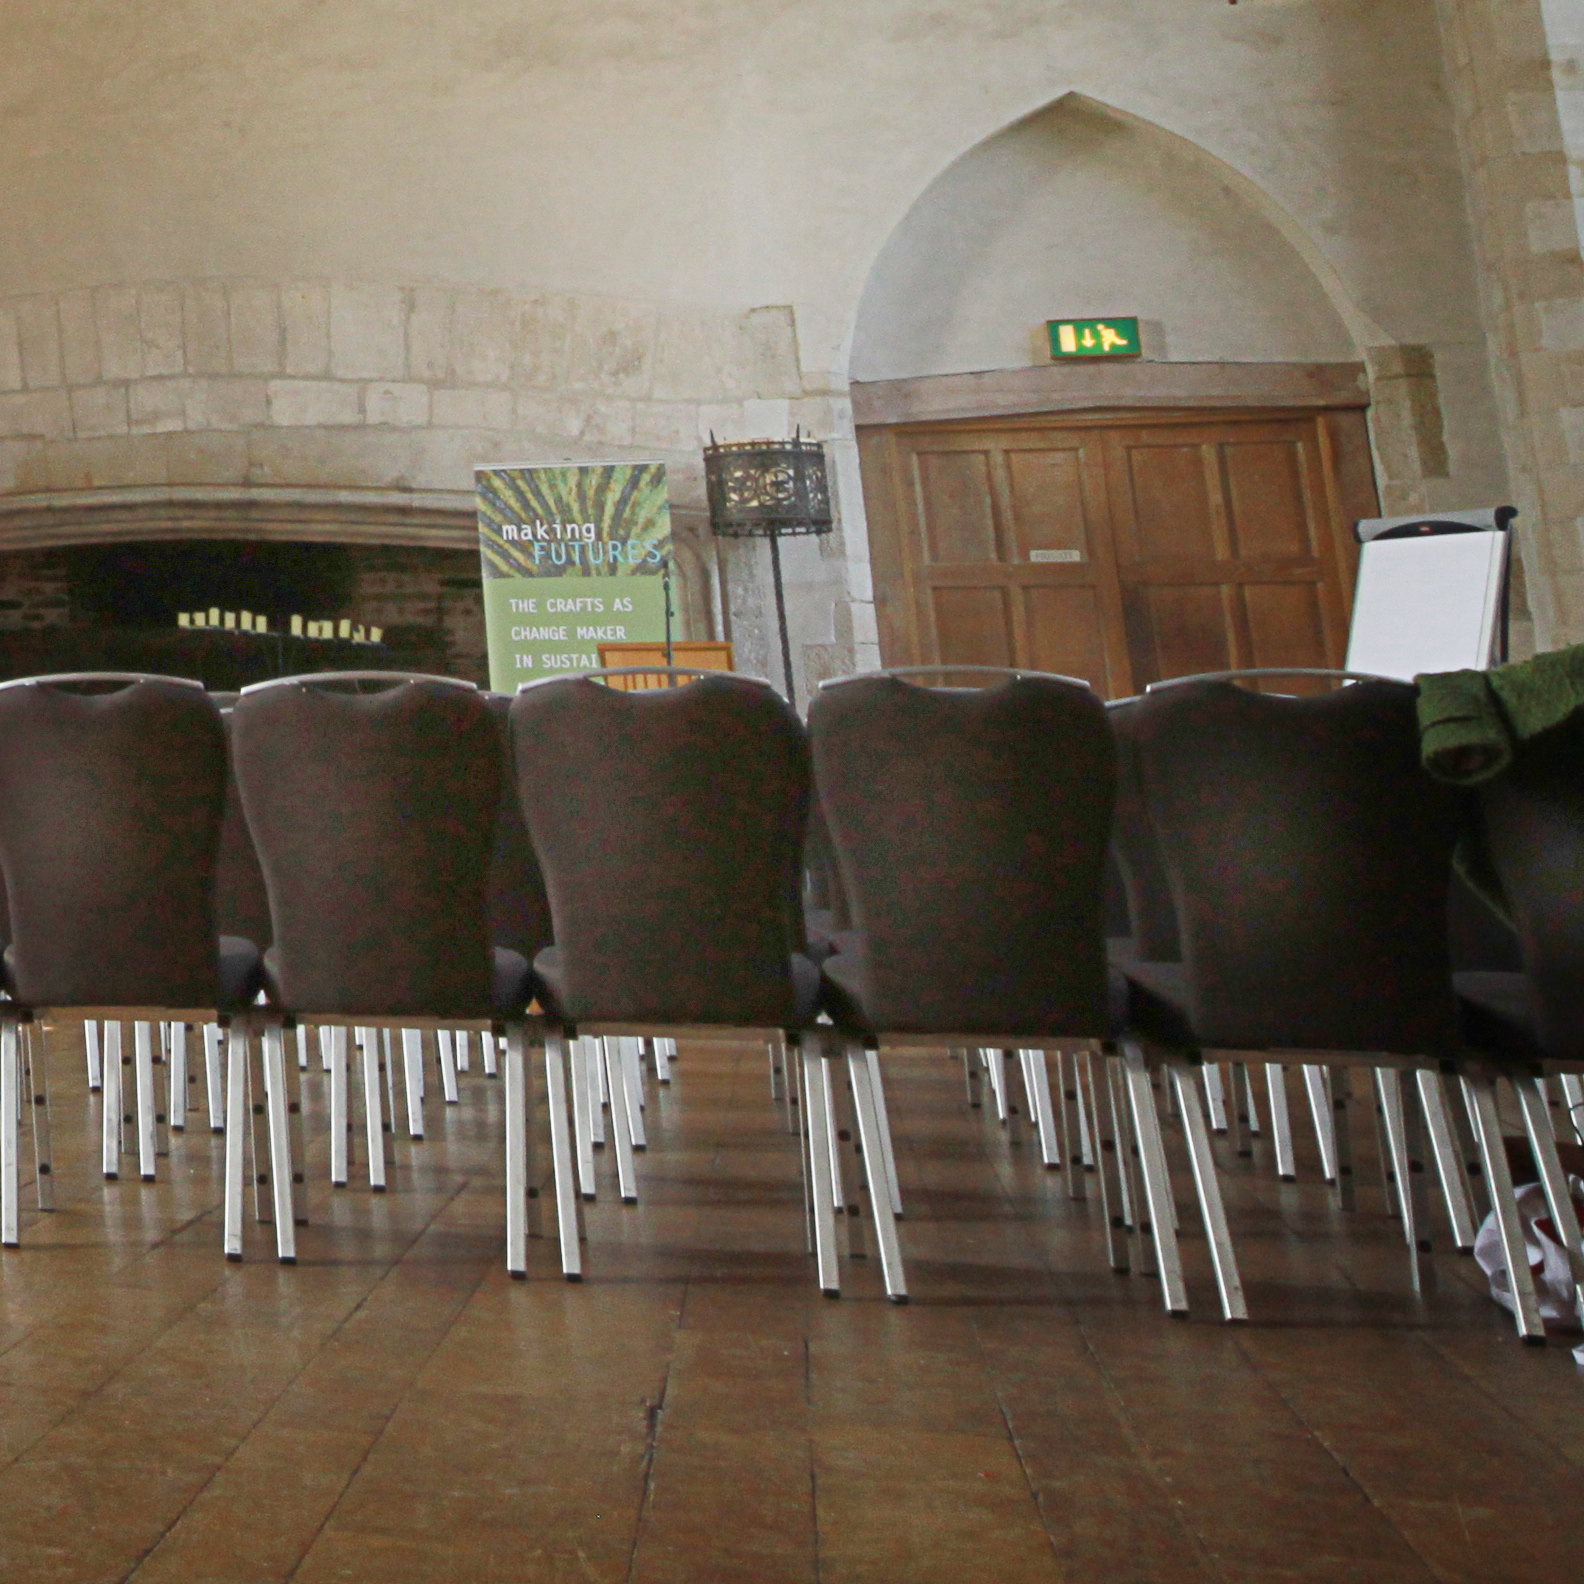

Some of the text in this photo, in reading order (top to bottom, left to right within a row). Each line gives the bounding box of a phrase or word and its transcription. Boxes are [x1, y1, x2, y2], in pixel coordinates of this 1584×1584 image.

[502, 520, 596, 542] making
[533, 539, 662, 565] FUTURES
[509, 597, 633, 613] THE CRAFTS AS
[511, 625, 627, 641] CHANGE MAKER
[515, 654, 533, 669] IN
